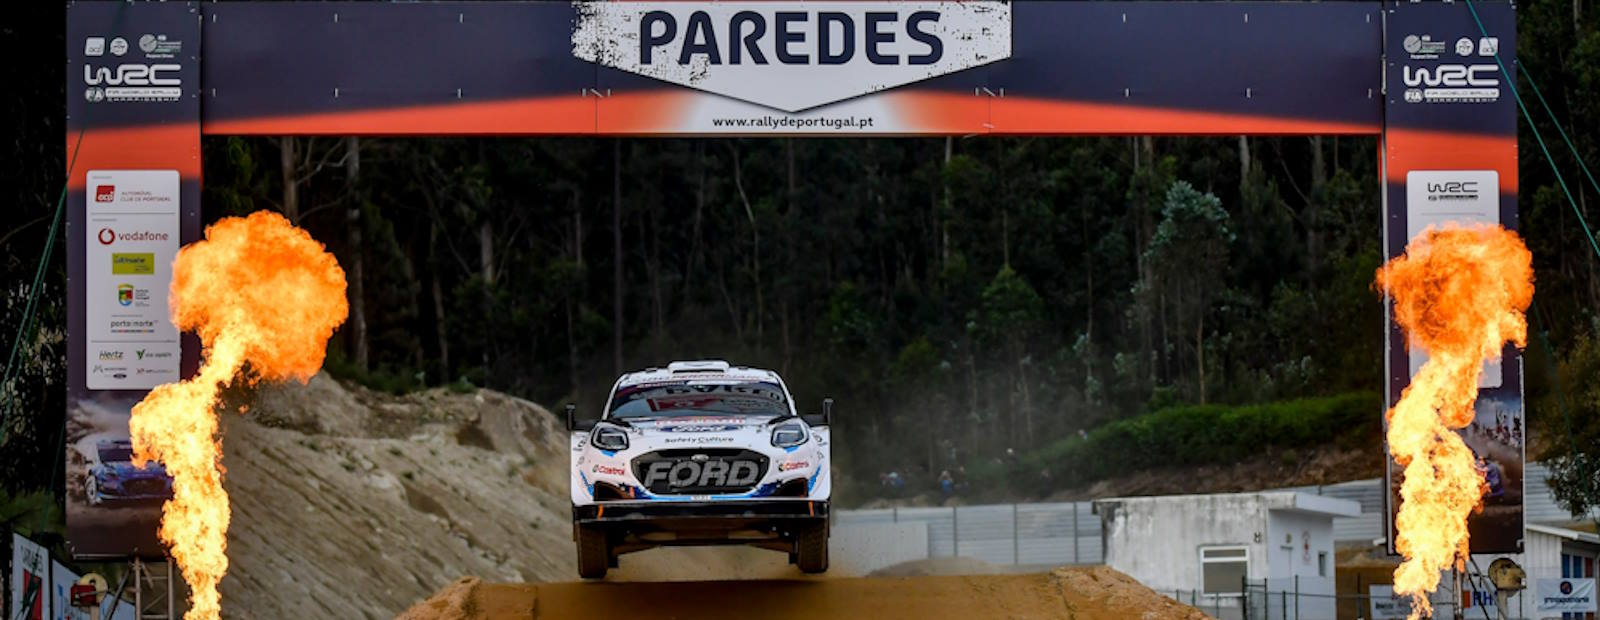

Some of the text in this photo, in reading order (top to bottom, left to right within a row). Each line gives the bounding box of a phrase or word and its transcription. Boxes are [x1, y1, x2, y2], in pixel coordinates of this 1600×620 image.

[638, 10, 944, 66] PAREDES
[84, 64, 182, 86] WRC
[1403, 64, 1500, 87] WRC
[712, 115, 874, 130] www.rallydeportugal.pt
[1427, 182, 1478, 192] WRC
[118, 231, 169, 241] vodafone
[644, 460, 759, 487] FORD
